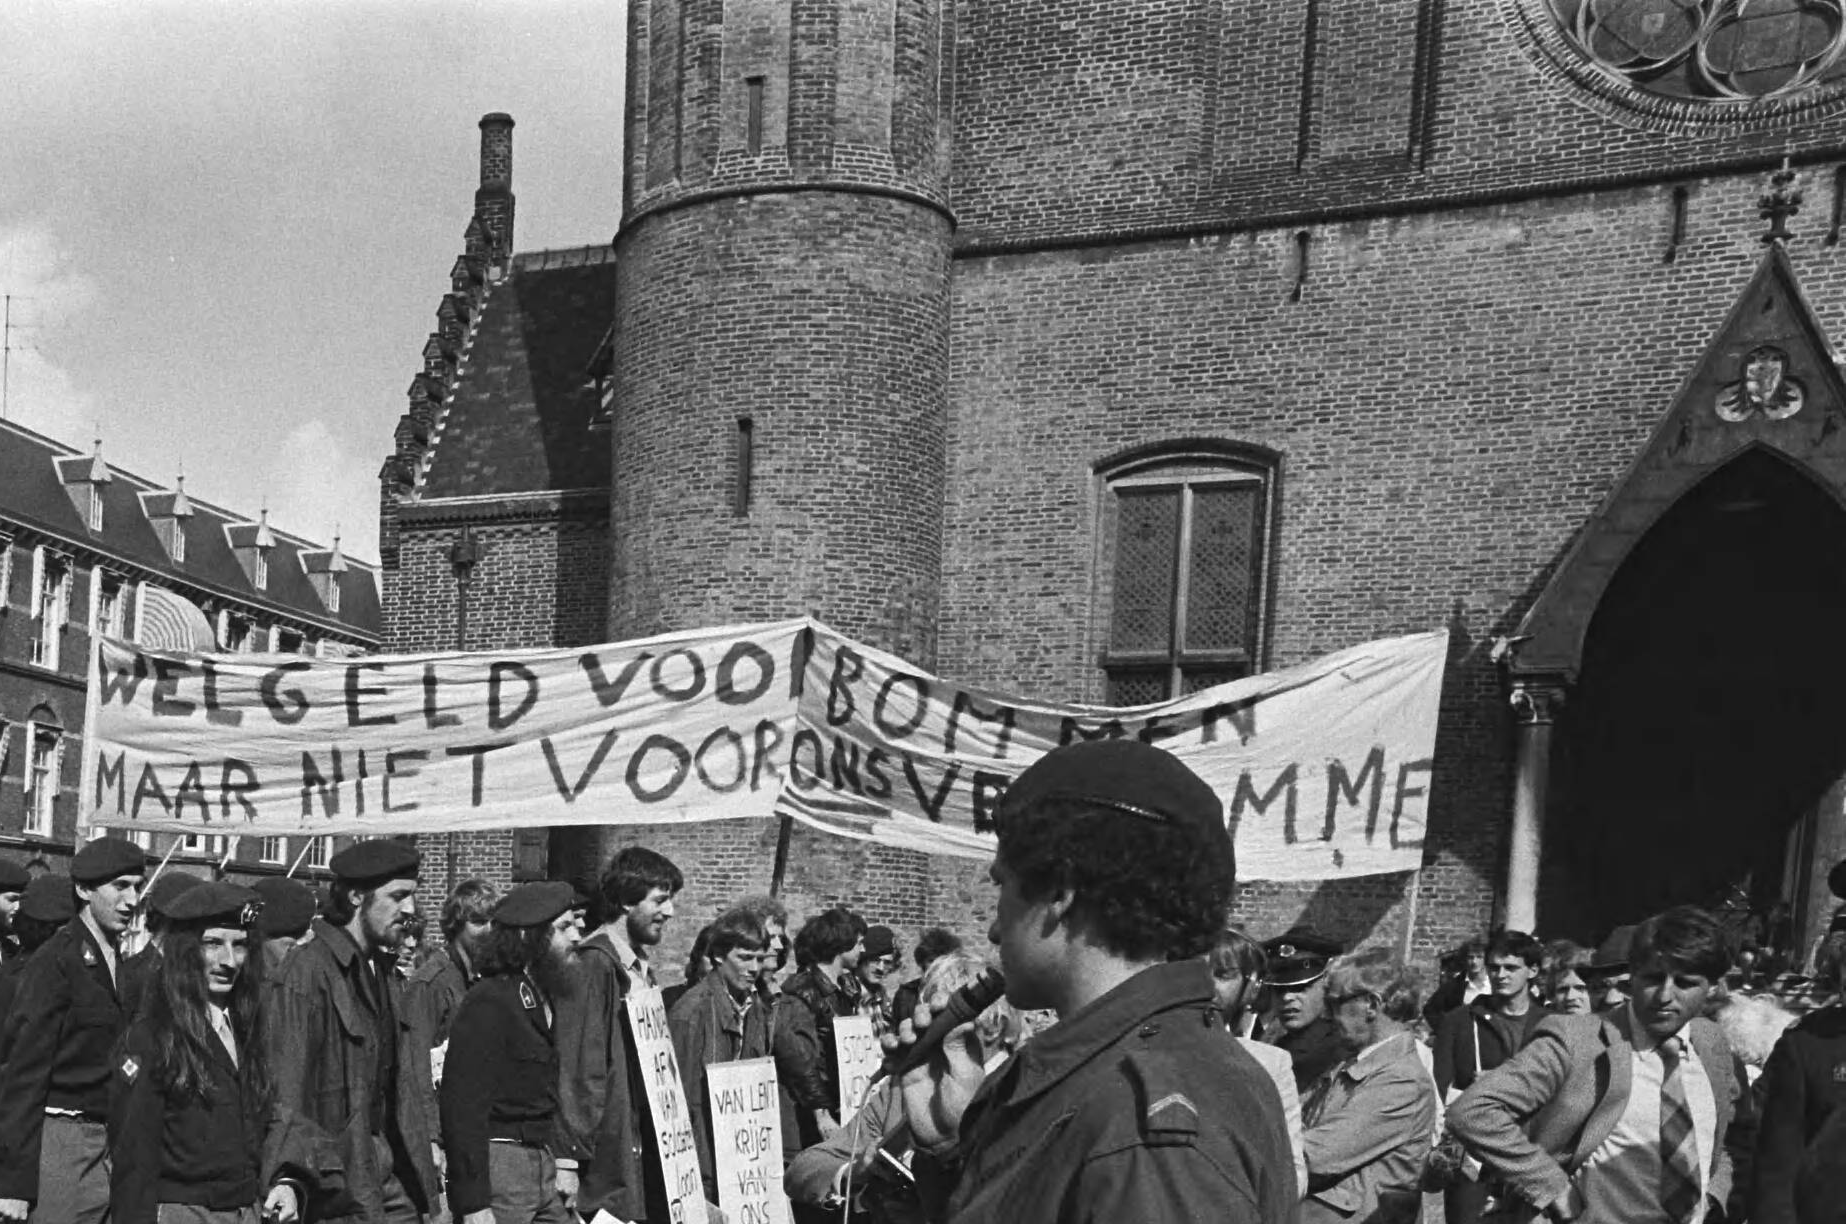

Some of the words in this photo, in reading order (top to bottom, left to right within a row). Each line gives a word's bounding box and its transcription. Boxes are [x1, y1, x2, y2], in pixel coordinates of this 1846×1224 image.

[98, 645, 243, 727] WEL
[261, 660, 541, 729] GELD
[95, 749, 261, 823] MAAR
[300, 743, 522, 819] NIET
[539, 718, 785, 803] VOOR
[788, 728, 893, 800] ONS
[714, 1086, 745, 1116] VAN
[736, 1165, 768, 1196] VAN
